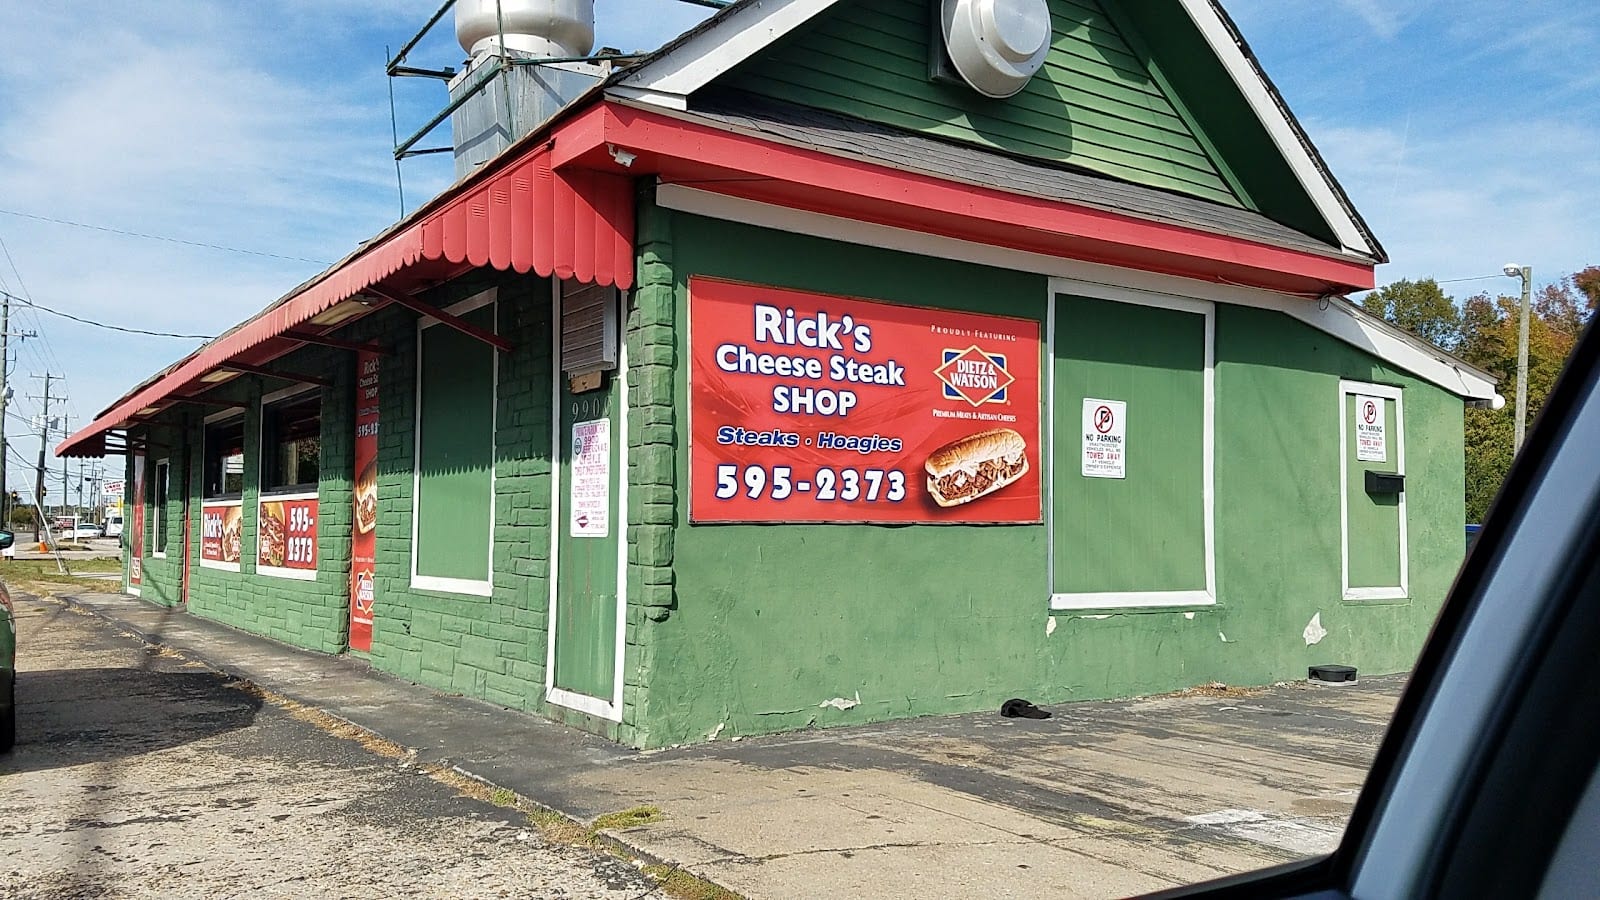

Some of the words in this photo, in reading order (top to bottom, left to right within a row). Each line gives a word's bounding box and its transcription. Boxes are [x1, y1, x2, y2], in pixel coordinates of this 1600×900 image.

[754, 303, 872, 353] Rick's
[930, 324, 971, 337] PROUDLY
[974, 329, 1017, 342] FEATURING
[715, 343, 823, 379] Cheese
[829, 354, 906, 386] Steak
[949, 372, 998, 389] WATSON
[772, 384, 857, 416] SHOP
[717, 426, 800, 447] Steaks
[816, 431, 903, 454] Hoagies
[1097, 435, 1122, 443] PARKING
[715, 463, 906, 502] 595-2373
[203, 512, 223, 538] Rick's
[289, 506, 315, 533] 595-
[287, 536, 314, 564] 2373
